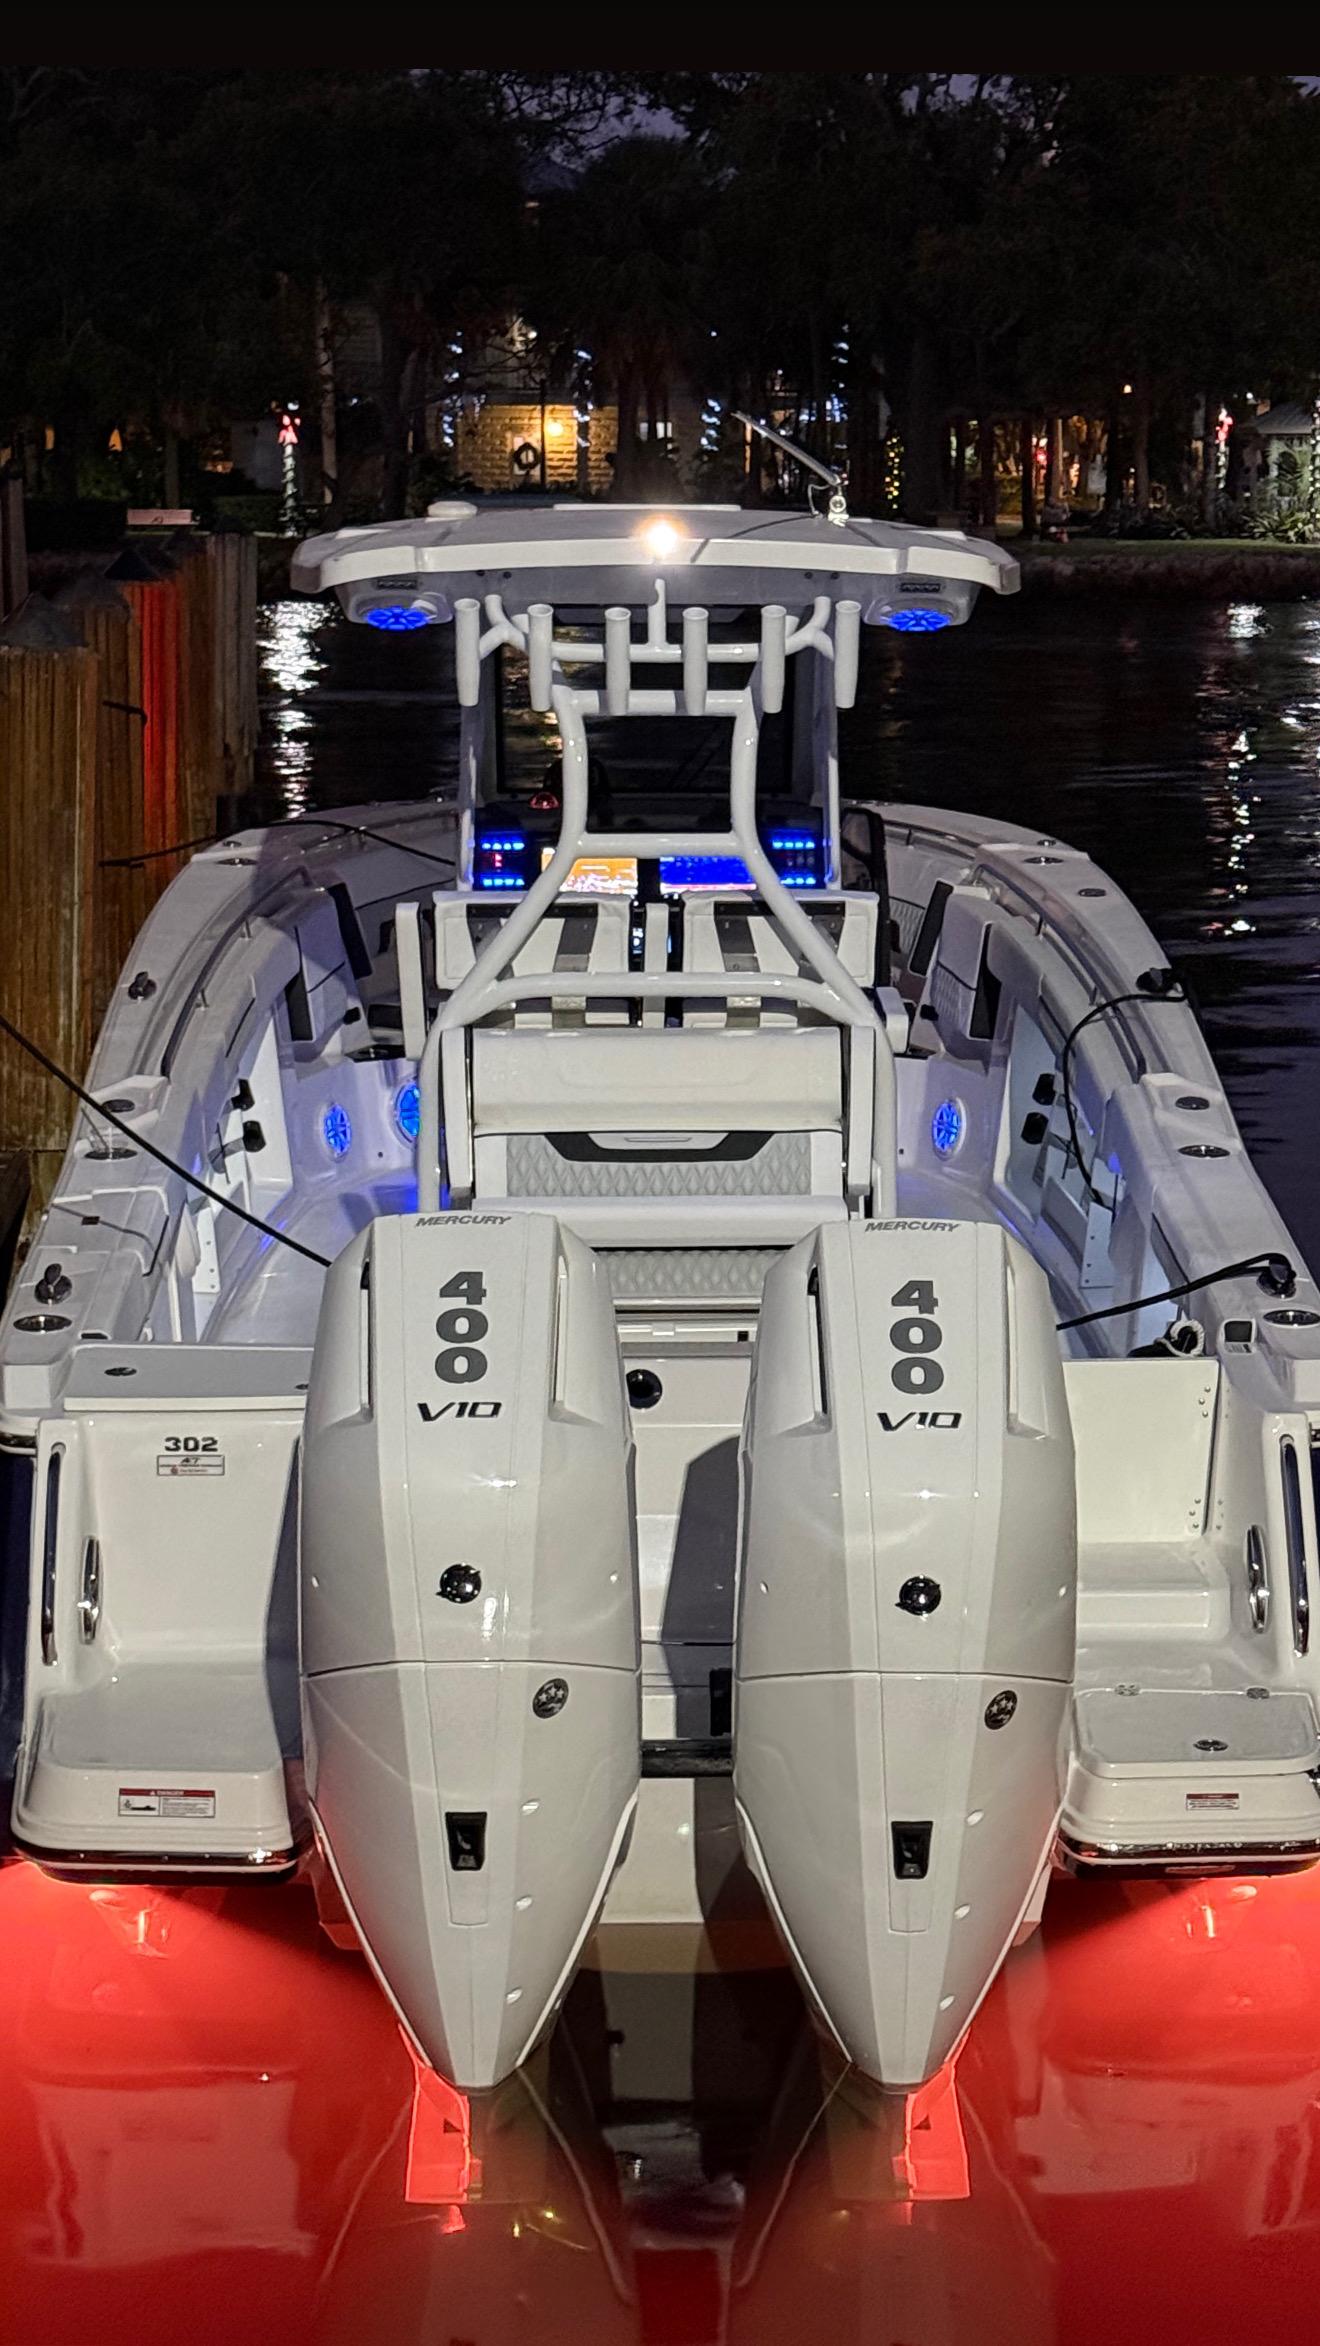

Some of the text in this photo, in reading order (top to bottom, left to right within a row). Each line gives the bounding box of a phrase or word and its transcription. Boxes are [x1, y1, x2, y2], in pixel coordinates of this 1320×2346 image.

[416, 1215, 512, 1227] MERCURY
[865, 1221, 960, 1232] MERCURY
[434, 1271, 489, 1384] 400
[889, 1280, 944, 1394] 400
[417, 1402, 502, 1422] V10
[877, 1412, 962, 1431] V10
[164, 1436, 218, 1452] 302
